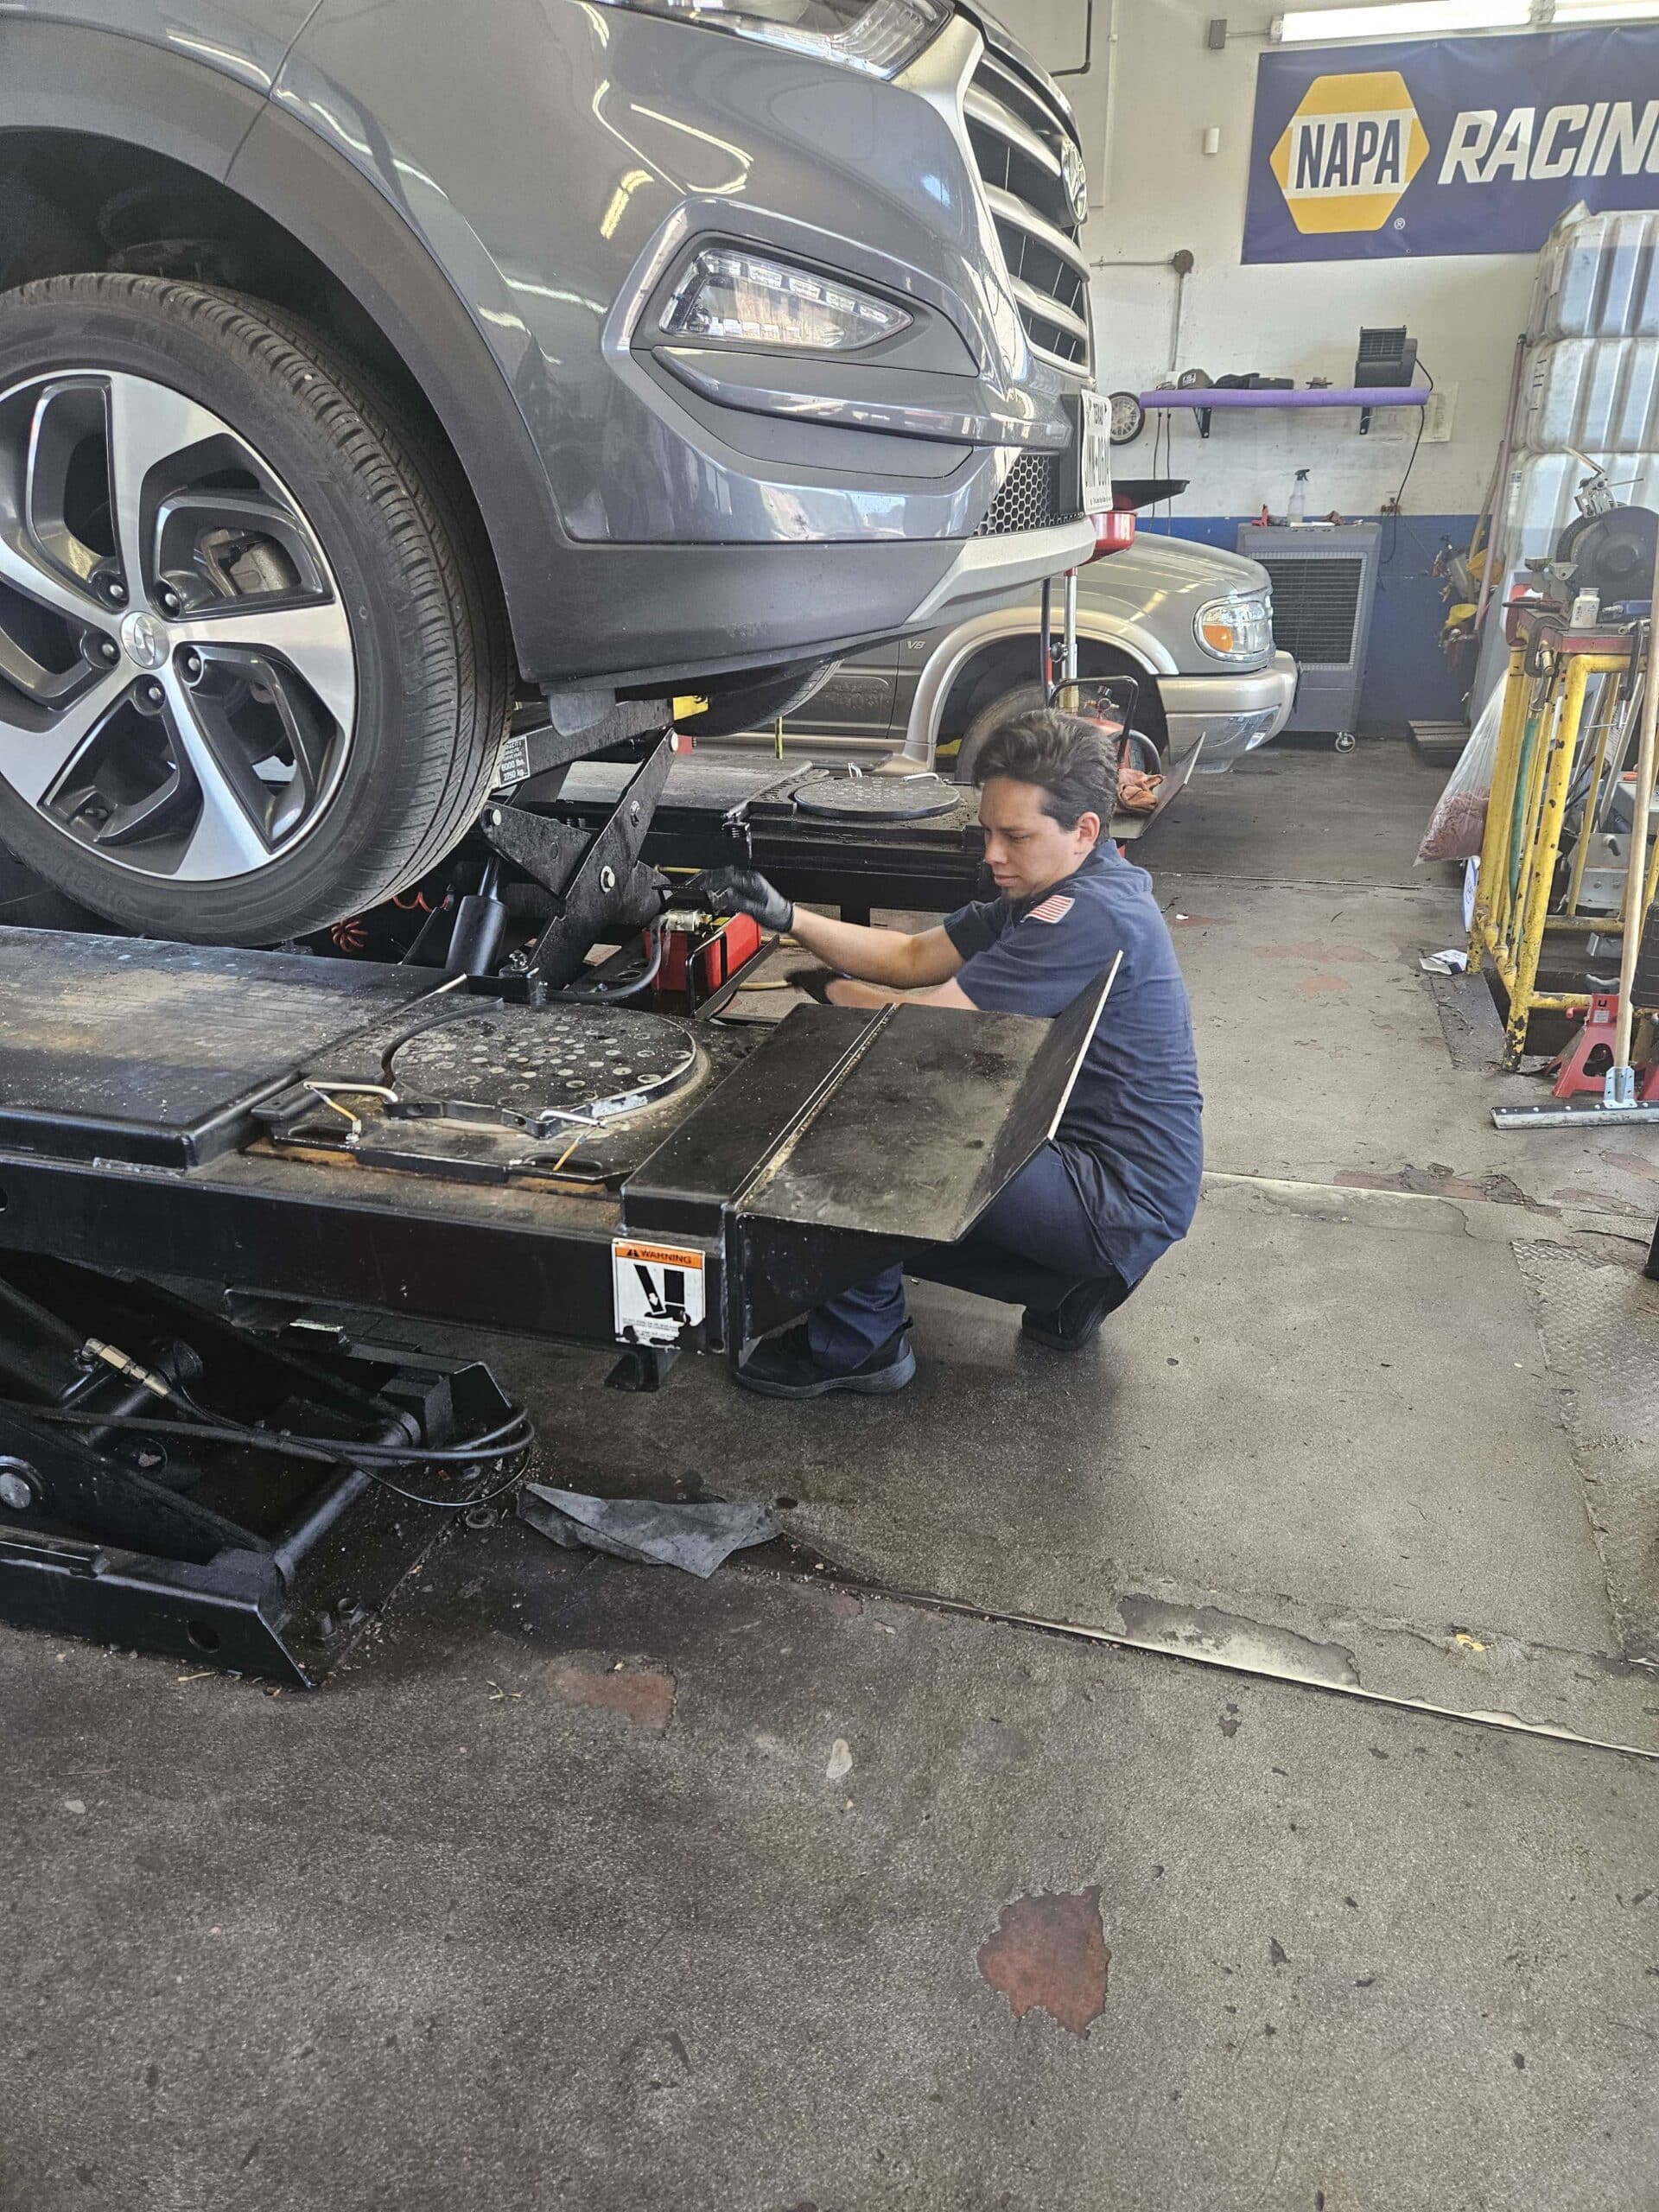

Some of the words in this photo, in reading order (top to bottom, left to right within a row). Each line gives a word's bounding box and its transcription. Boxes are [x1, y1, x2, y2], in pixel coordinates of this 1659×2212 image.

[1295, 118, 1401, 189] NAPA
[907, 640, 925, 649] V8
[641, 1249, 691, 1263] WARNING
